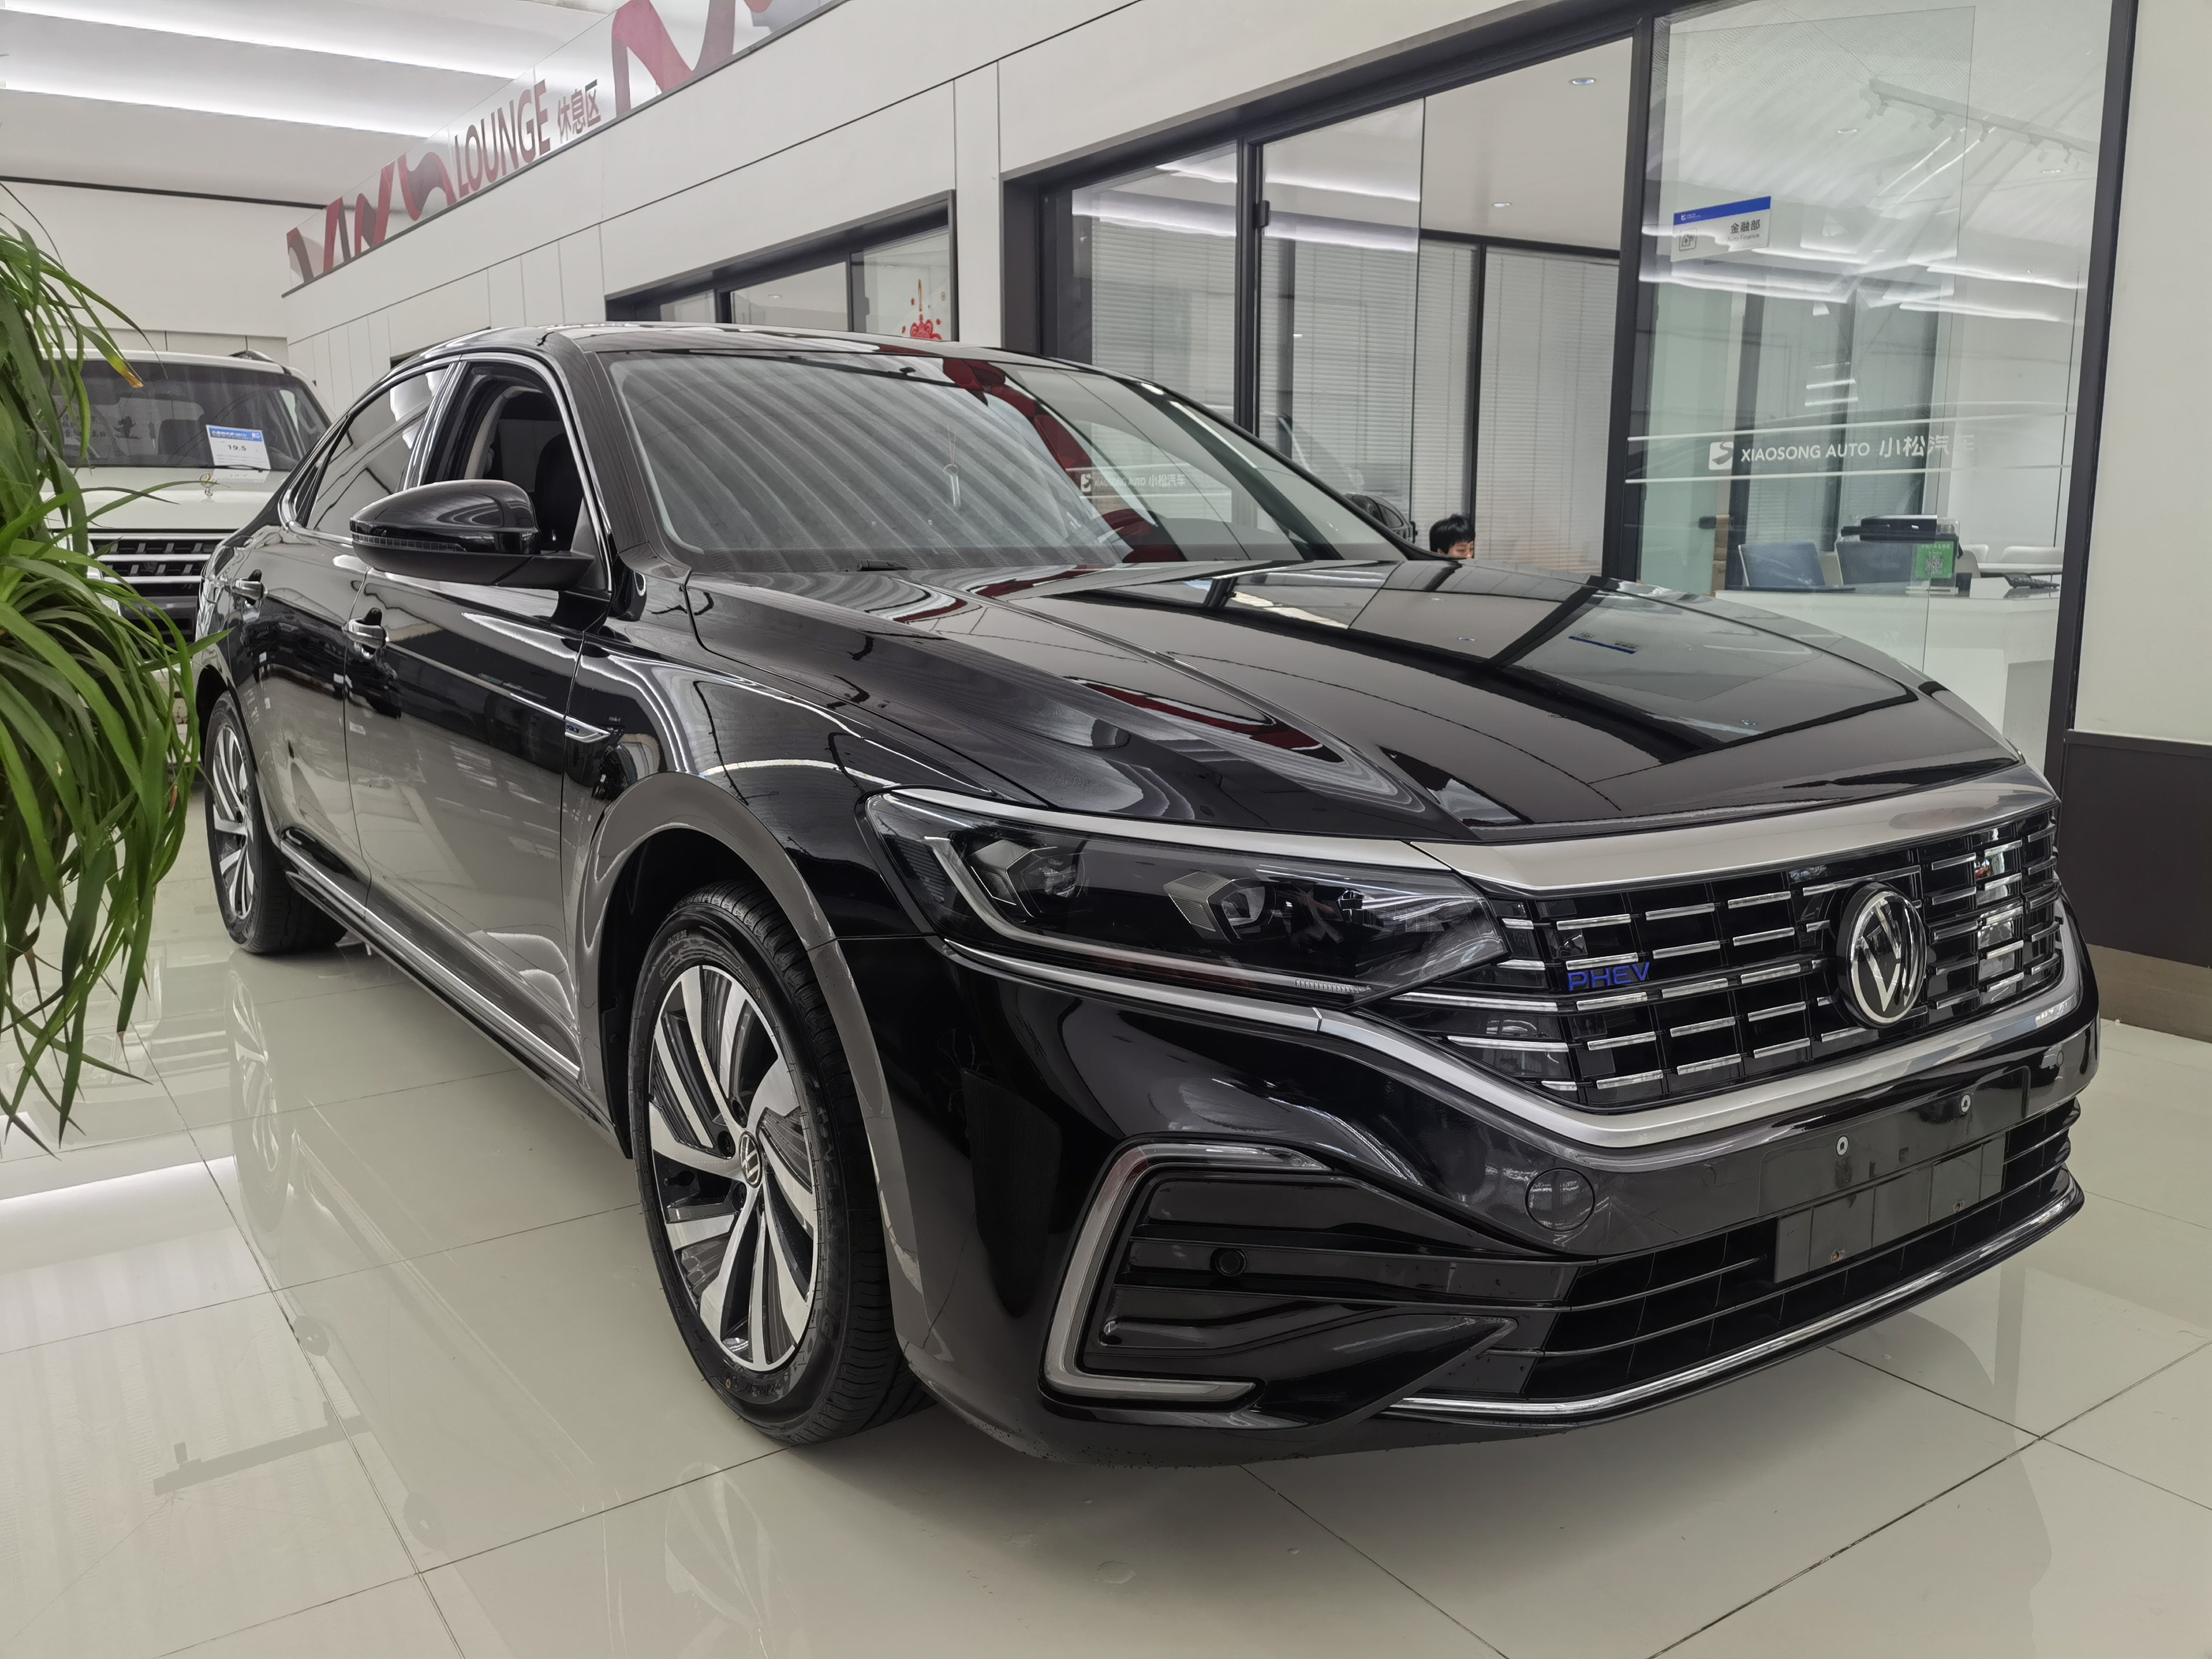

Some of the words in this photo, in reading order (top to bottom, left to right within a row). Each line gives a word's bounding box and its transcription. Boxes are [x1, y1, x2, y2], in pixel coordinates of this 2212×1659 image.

[557, 79, 601, 144] 休息区
[455, 79, 551, 198] LOUNGE
[1730, 219, 1761, 234] 金融部
[1741, 445, 1821, 462] XIAOSONG
[1825, 442, 1870, 457] AUTO
[1568, 962, 1650, 992] PHEV
